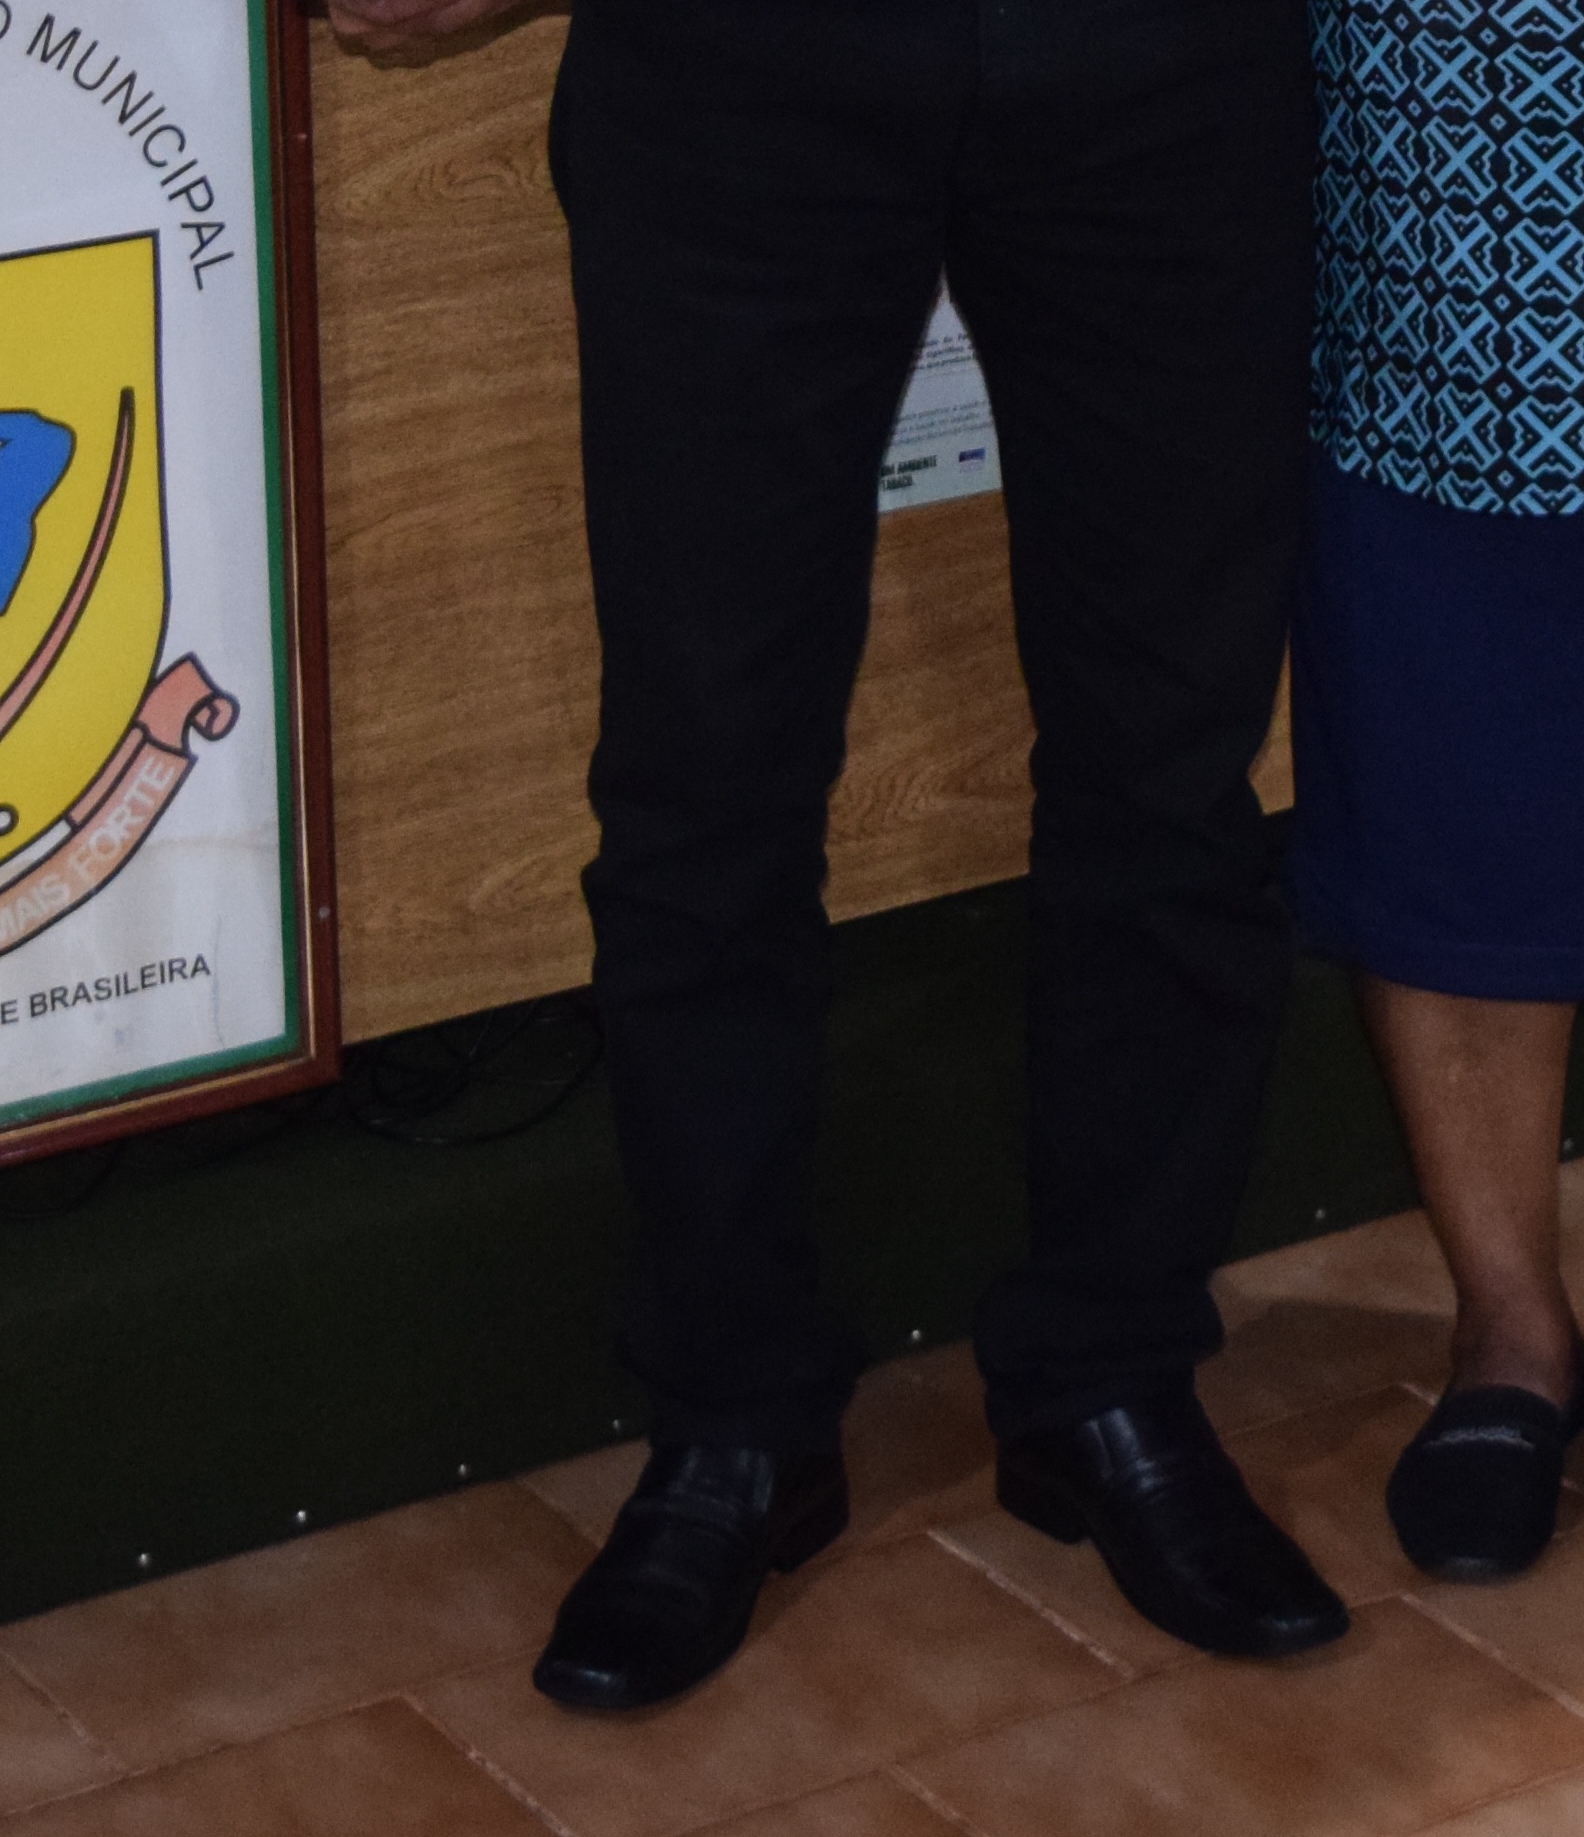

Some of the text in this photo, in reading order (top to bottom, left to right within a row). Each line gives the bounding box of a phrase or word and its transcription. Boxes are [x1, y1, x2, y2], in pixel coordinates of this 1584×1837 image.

[26, 12, 234, 291] MUNICIPAL
[68, 757, 175, 884] FORTE
[30, 953, 211, 1018] BRASILEIRA
